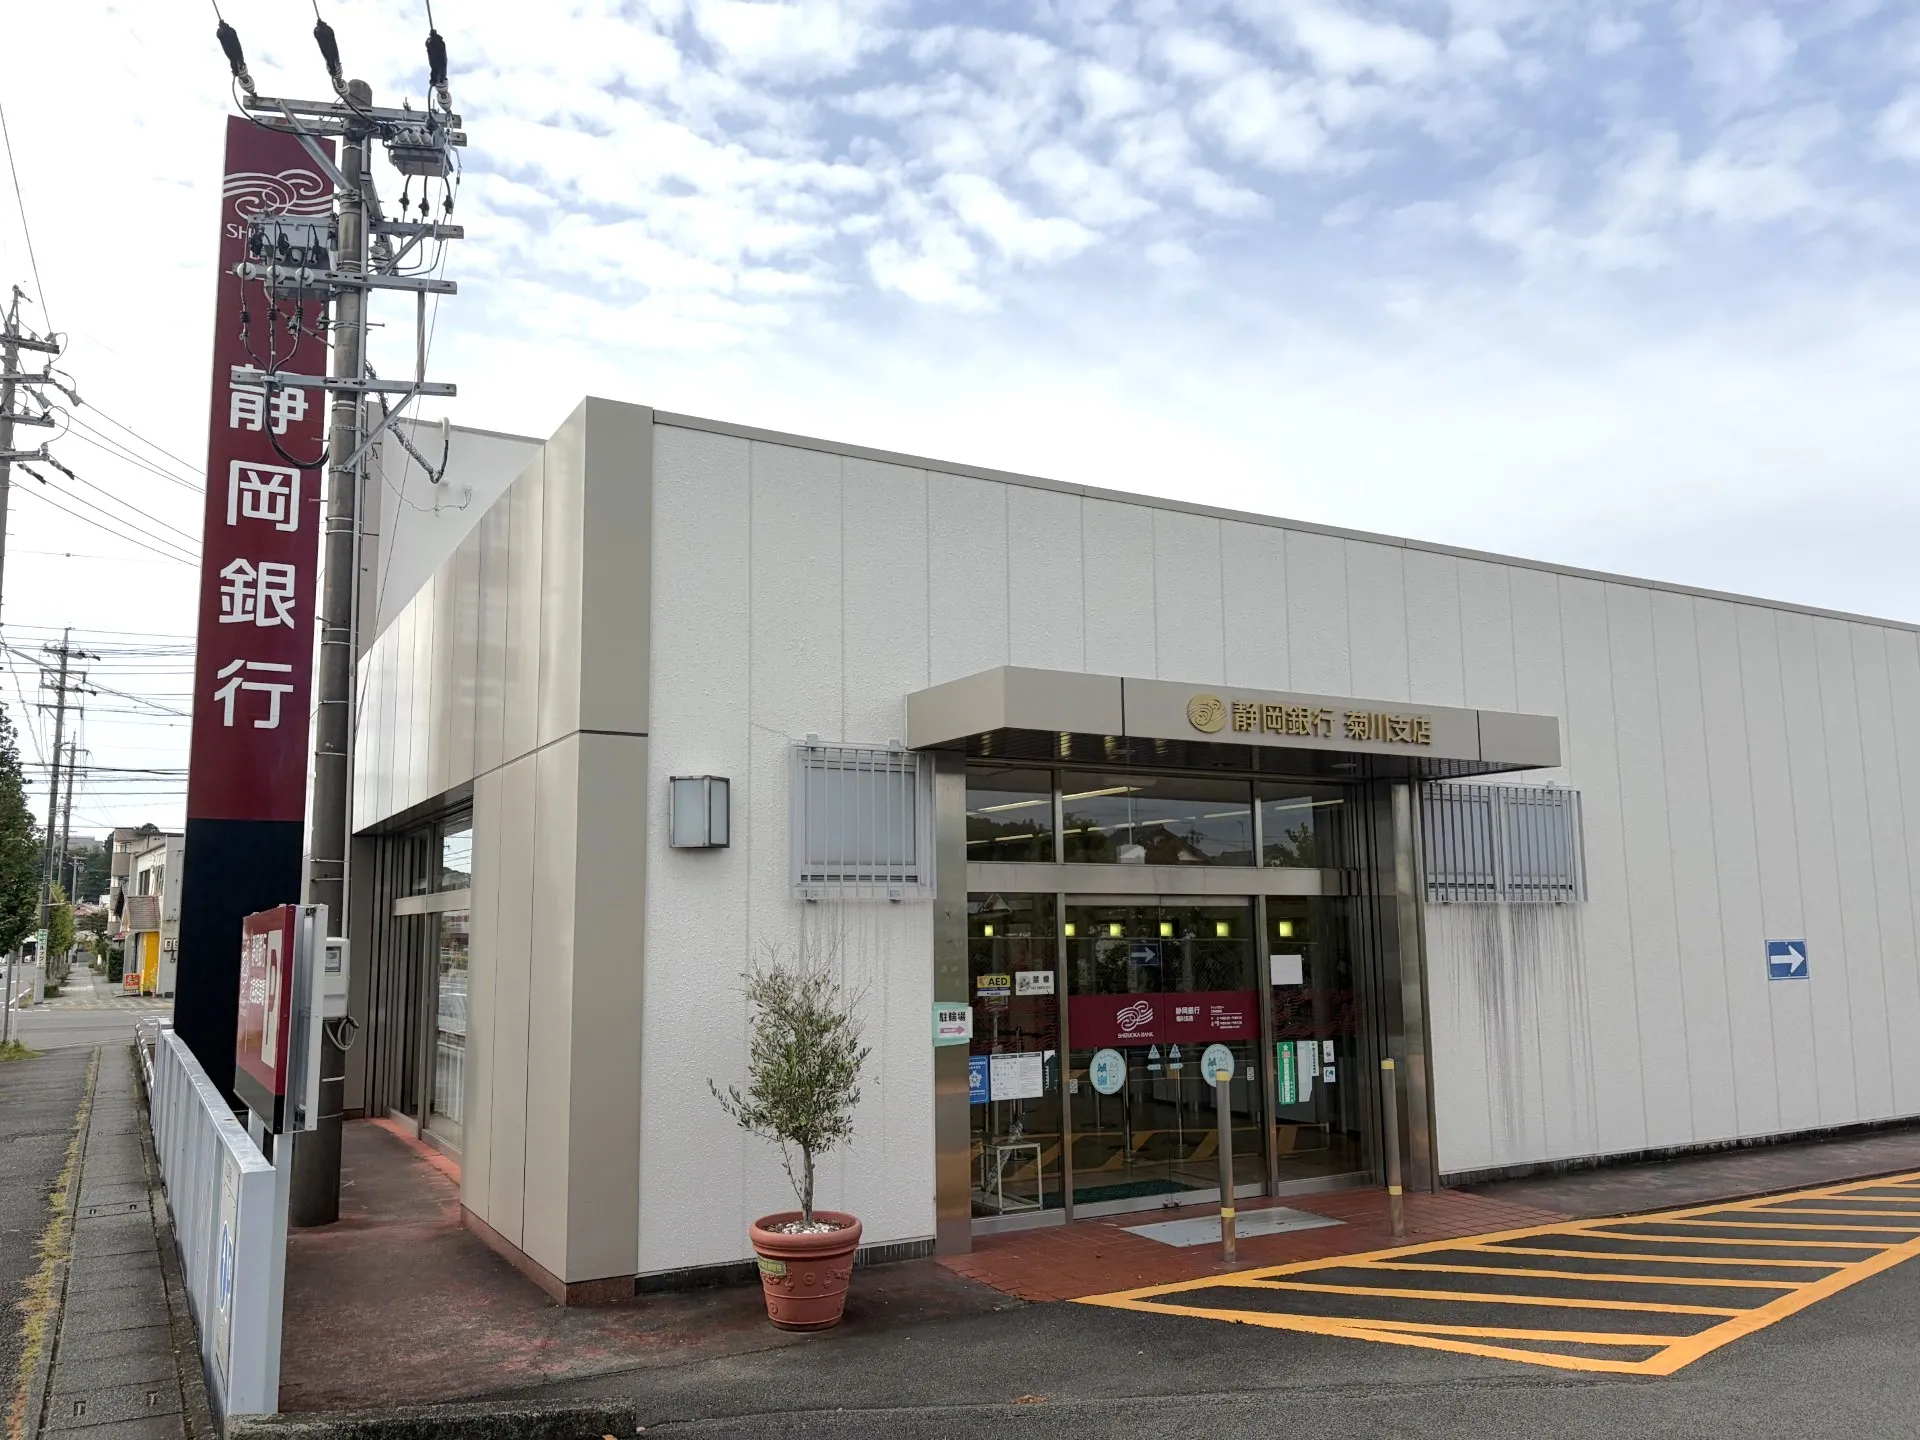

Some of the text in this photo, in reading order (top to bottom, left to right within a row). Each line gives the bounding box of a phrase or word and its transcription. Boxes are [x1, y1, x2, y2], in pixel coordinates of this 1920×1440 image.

[214, 364, 308, 729] 静岡銀行
[1231, 700, 1432, 745] 静岡銀行 菊川支店
[988, 977, 1008, 986] AED
[939, 1011, 966, 1023] 駐輪場
